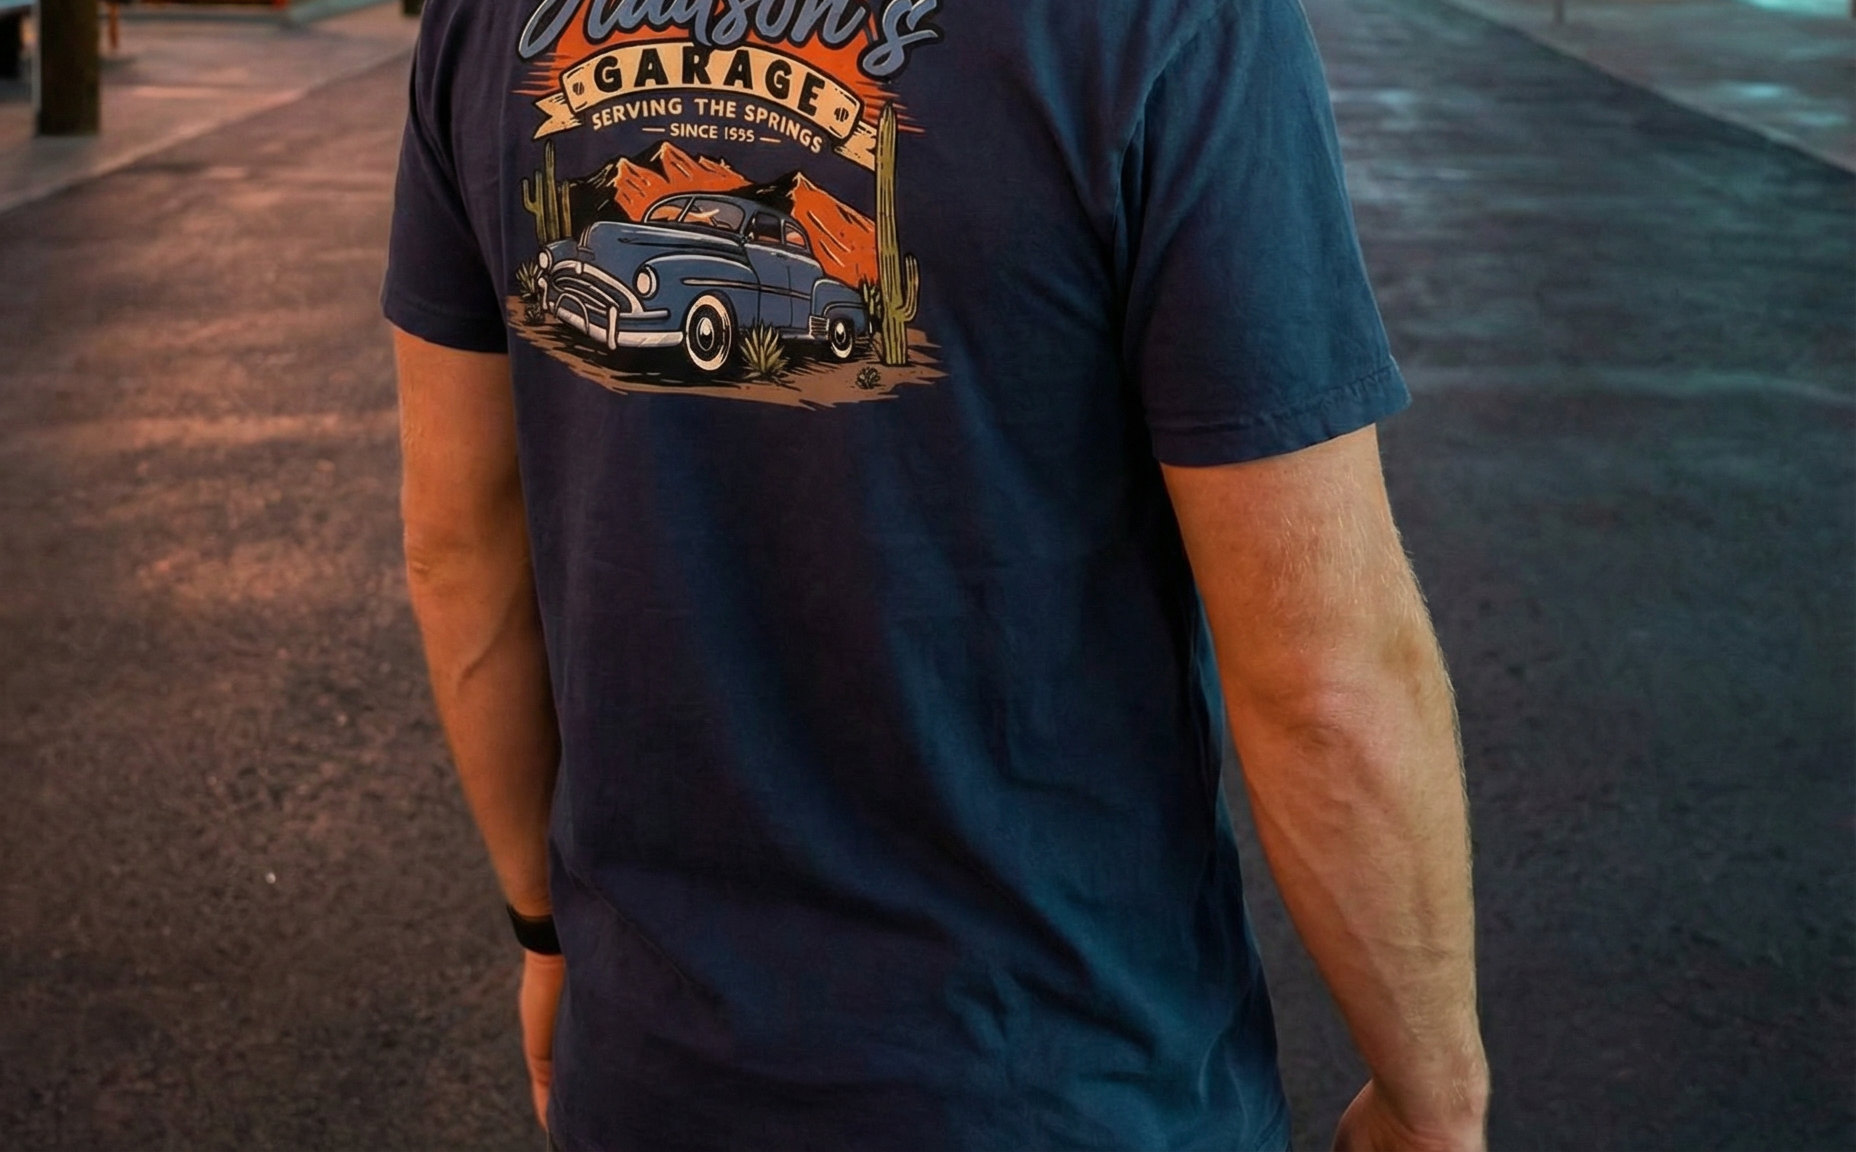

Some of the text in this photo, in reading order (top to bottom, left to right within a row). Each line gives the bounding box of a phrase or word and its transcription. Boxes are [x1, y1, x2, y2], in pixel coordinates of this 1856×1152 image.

[593, 45, 826, 117] GARAGE
[591, 97, 824, 154] SERVING THE SPRINGS
[669, 122, 718, 139] SINCE
